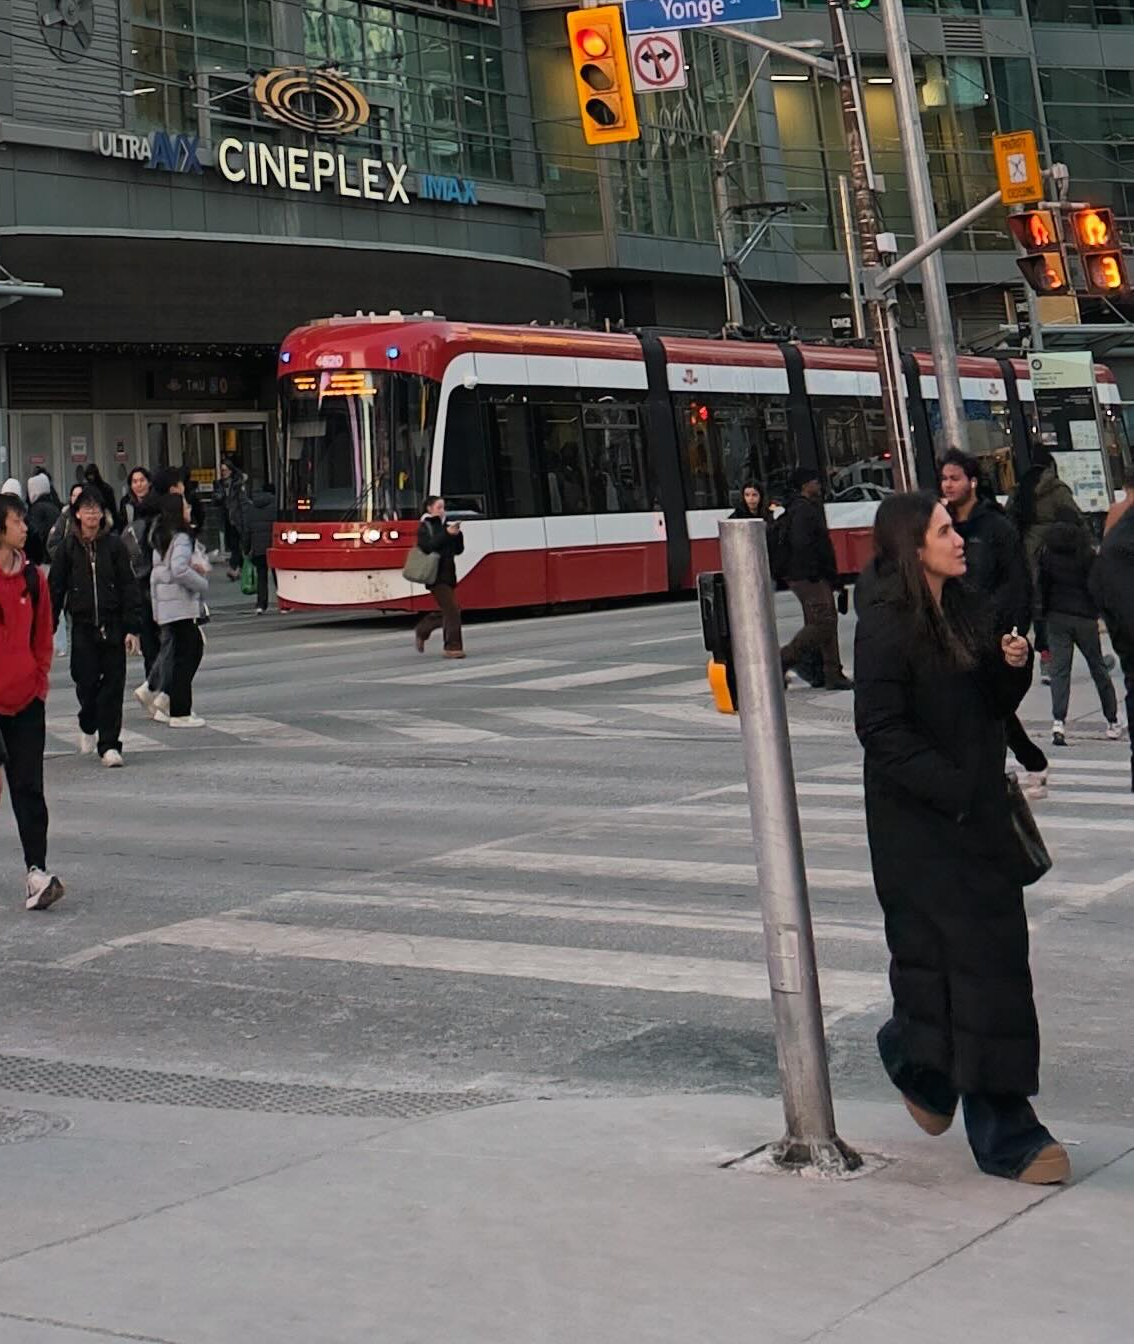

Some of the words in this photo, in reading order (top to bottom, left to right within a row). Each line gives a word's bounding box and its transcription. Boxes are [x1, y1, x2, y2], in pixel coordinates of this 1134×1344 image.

[98, 131, 152, 162] ULTRA
[217, 137, 410, 204] CINEPLEX
[422, 172, 479, 206] IMAX
[1102, 257, 1122, 289] 3
